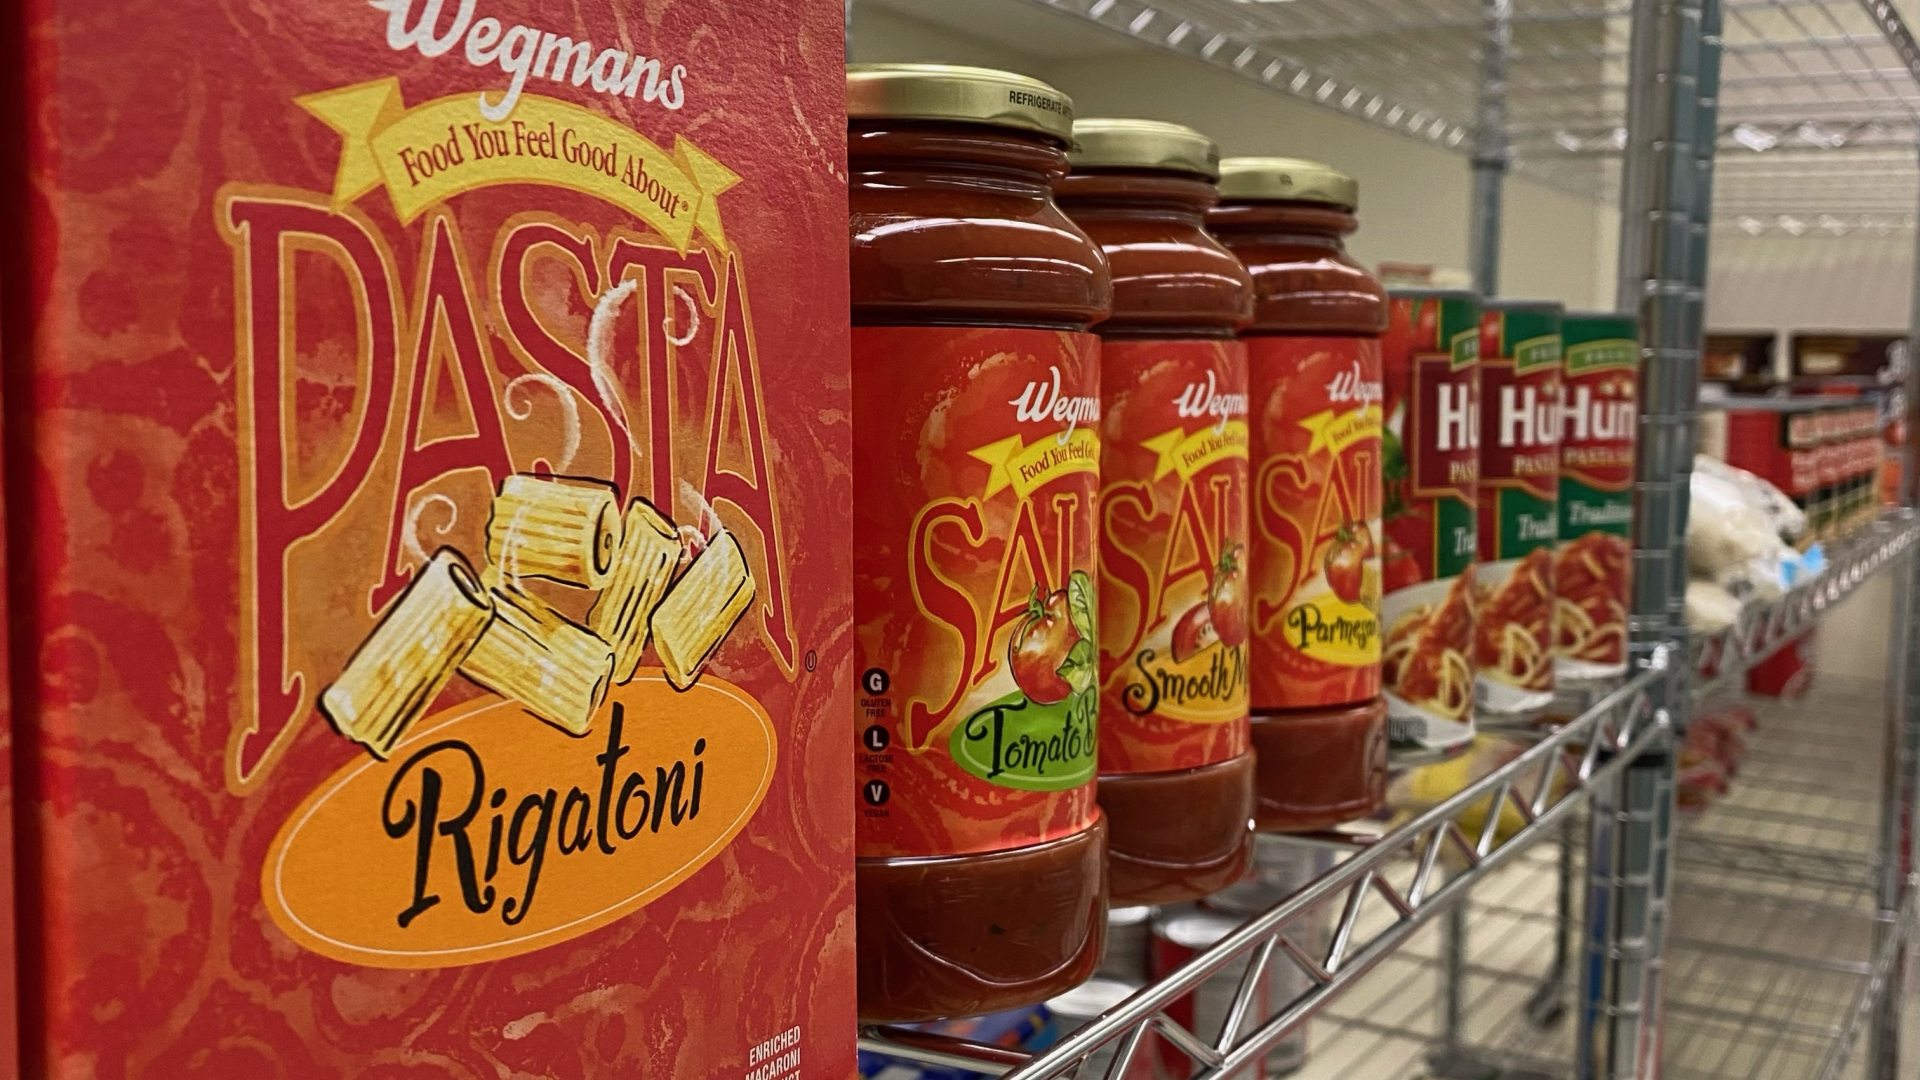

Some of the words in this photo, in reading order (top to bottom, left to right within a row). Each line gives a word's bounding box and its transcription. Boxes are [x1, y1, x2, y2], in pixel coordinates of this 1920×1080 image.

[368, 0, 688, 121] Wegmans
[1009, 90, 1062, 115] REFRIGERATE
[397, 125, 464, 188] Food
[462, 122, 511, 161] You
[511, 120, 559, 160] Feel
[562, 128, 617, 178] Good
[1018, 452, 1050, 483] Food
[1050, 446, 1067, 466] You
[1068, 440, 1084, 460] Feel
[225, 193, 798, 787] PASTA
[869, 673, 883, 691] G
[1122, 648, 1228, 716] Smooth
[865, 708, 887, 718] FREE
[872, 730, 883, 747] L
[965, 696, 1081, 778] Tomato
[381, 702, 707, 928] Rigatoni
[871, 785, 883, 802] V
[749, 1025, 801, 1067] ENRICHED
